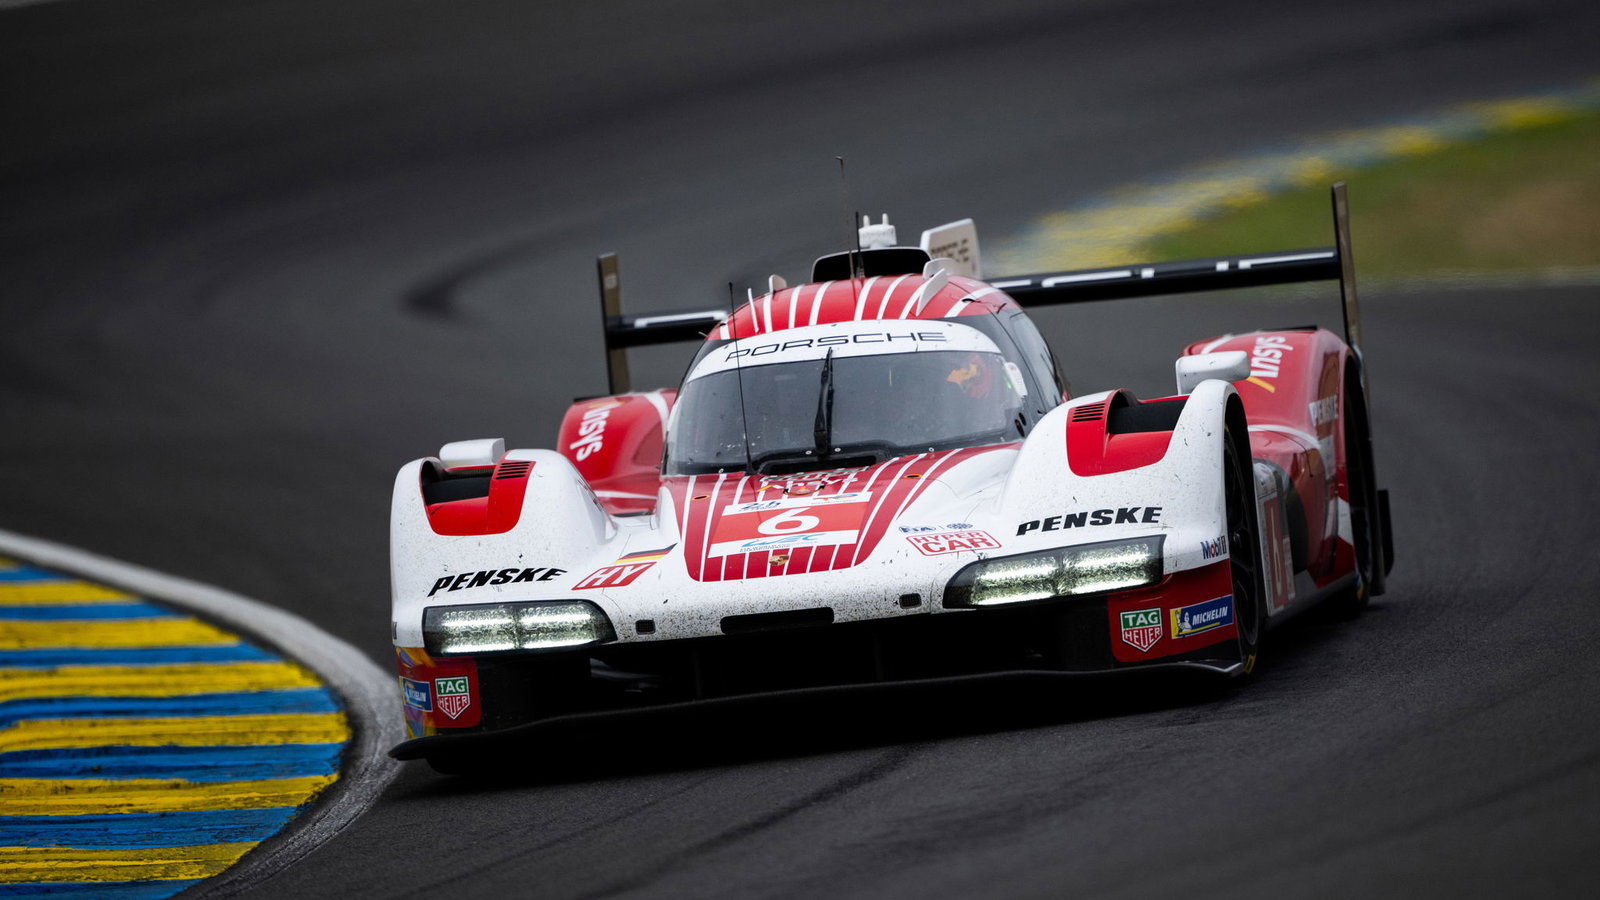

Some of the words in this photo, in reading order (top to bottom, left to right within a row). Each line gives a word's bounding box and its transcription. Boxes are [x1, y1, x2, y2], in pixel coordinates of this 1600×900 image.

[725, 332, 947, 362] PORSCHE
[757, 508, 820, 535] 6
[1016, 506, 1163, 536] PENSKE
[913, 532, 984, 543] HYPER
[921, 538, 994, 553] CAR
[427, 567, 568, 597] PENSKE
[574, 563, 655, 588] HY
[1124, 611, 1158, 627] TAG
[1192, 606, 1228, 626] MICHELIN
[1124, 627, 1161, 649] HEUER
[437, 680, 466, 694] TAG
[438, 695, 469, 716] HEUER
